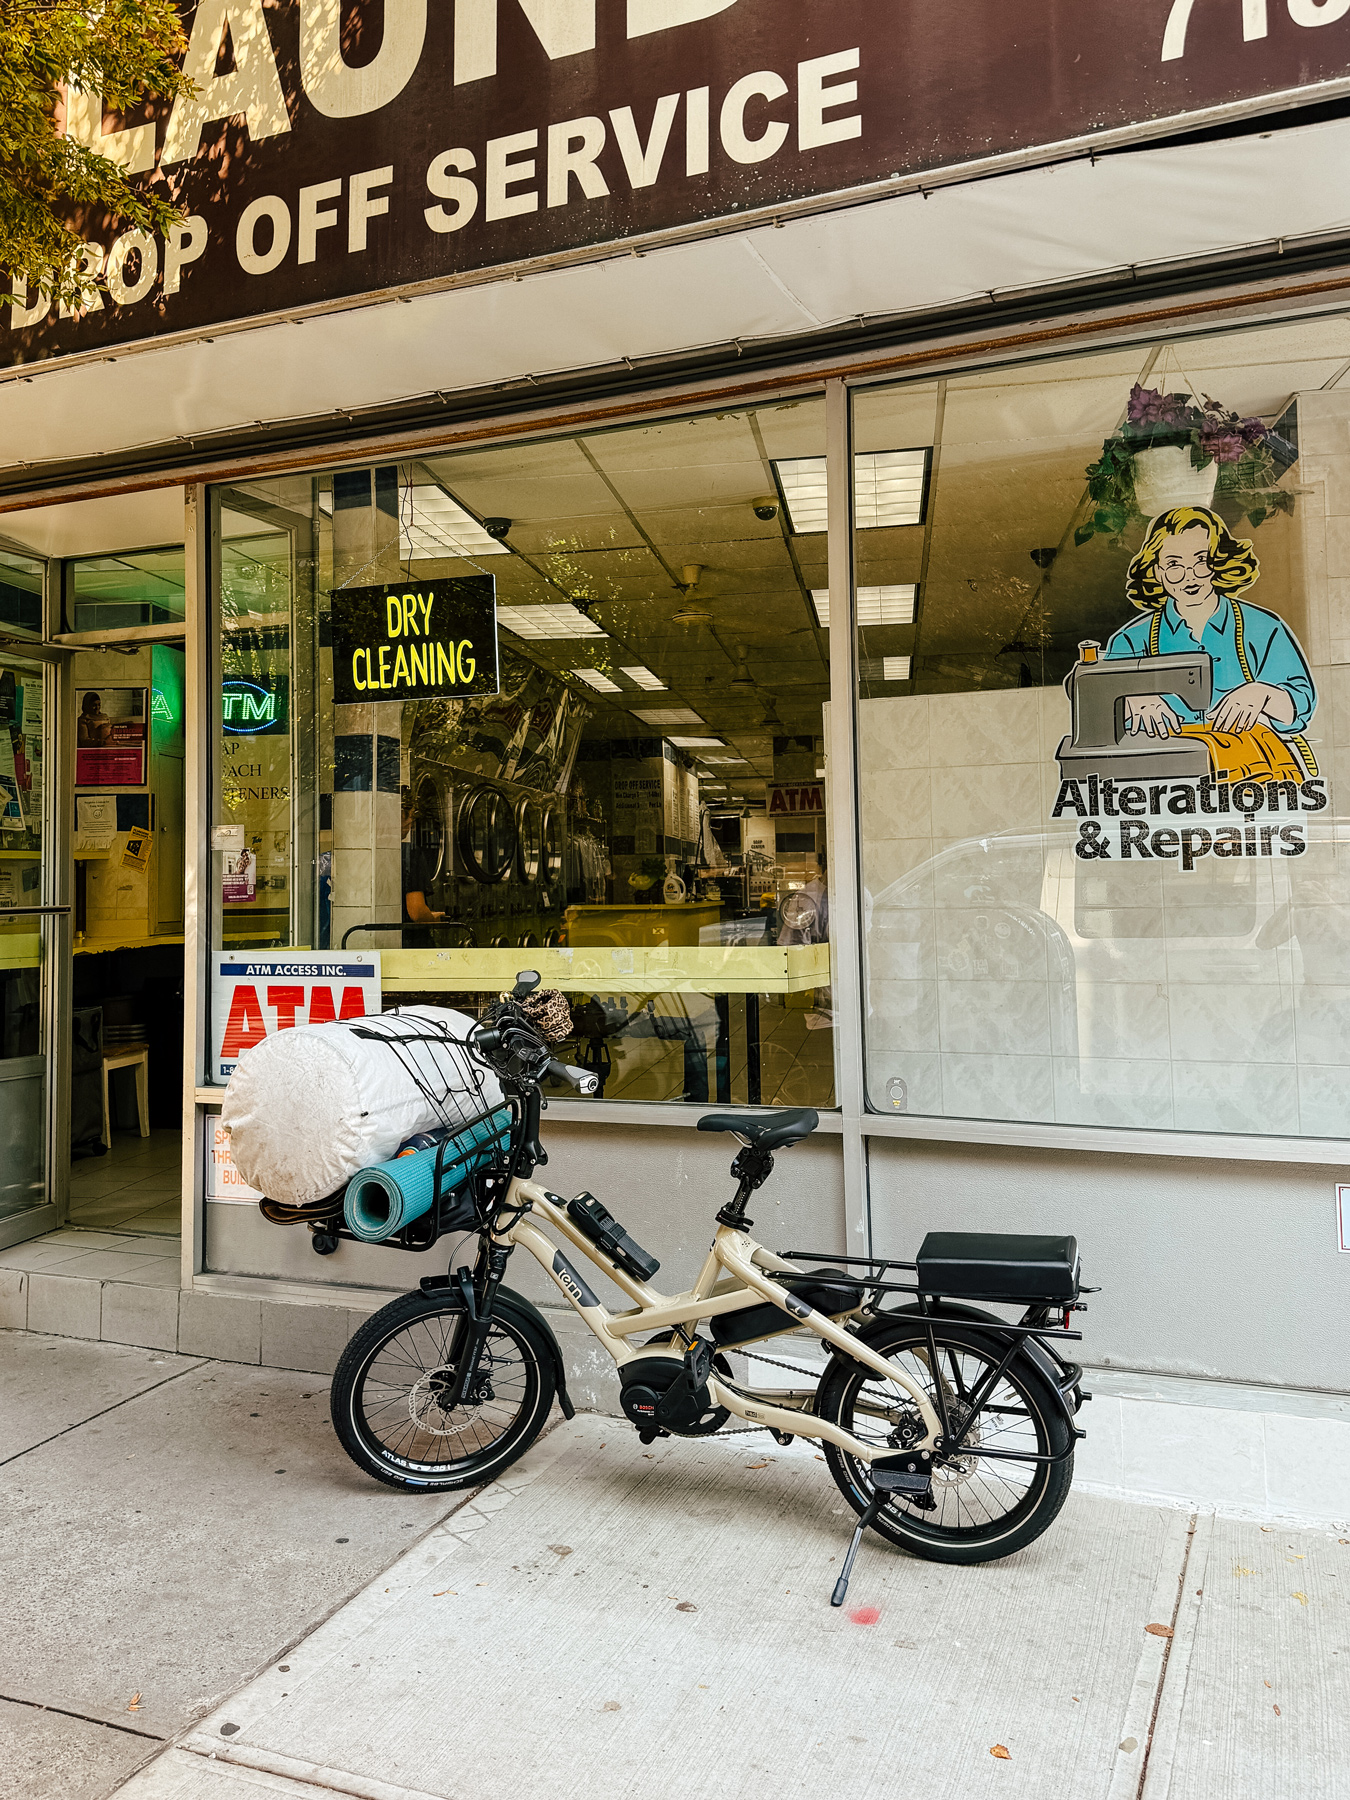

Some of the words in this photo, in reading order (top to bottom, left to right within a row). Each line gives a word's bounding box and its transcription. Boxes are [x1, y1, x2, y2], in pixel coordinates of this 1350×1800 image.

[10, 214, 208, 331] DROP
[236, 164, 393, 275] OFF
[424, 47, 862, 234] SERVICE
[386, 592, 434, 638] DRY
[352, 639, 476, 691] CLEANING
[629, 780, 638, 790] OFF
[639, 779, 661, 790] SERVICE
[769, 788, 823, 812] ATM
[1051, 770, 1328, 818] Alterations
[1075, 820, 1112, 859] &
[1119, 812, 1306, 871] Repairs
[246, 965, 272, 976] ATM
[275, 965, 318, 976] ACCESS
[321, 965, 347, 977] INC.
[558, 1268, 583, 1301] tern
[381, 1449, 408, 1467] ATLAS
